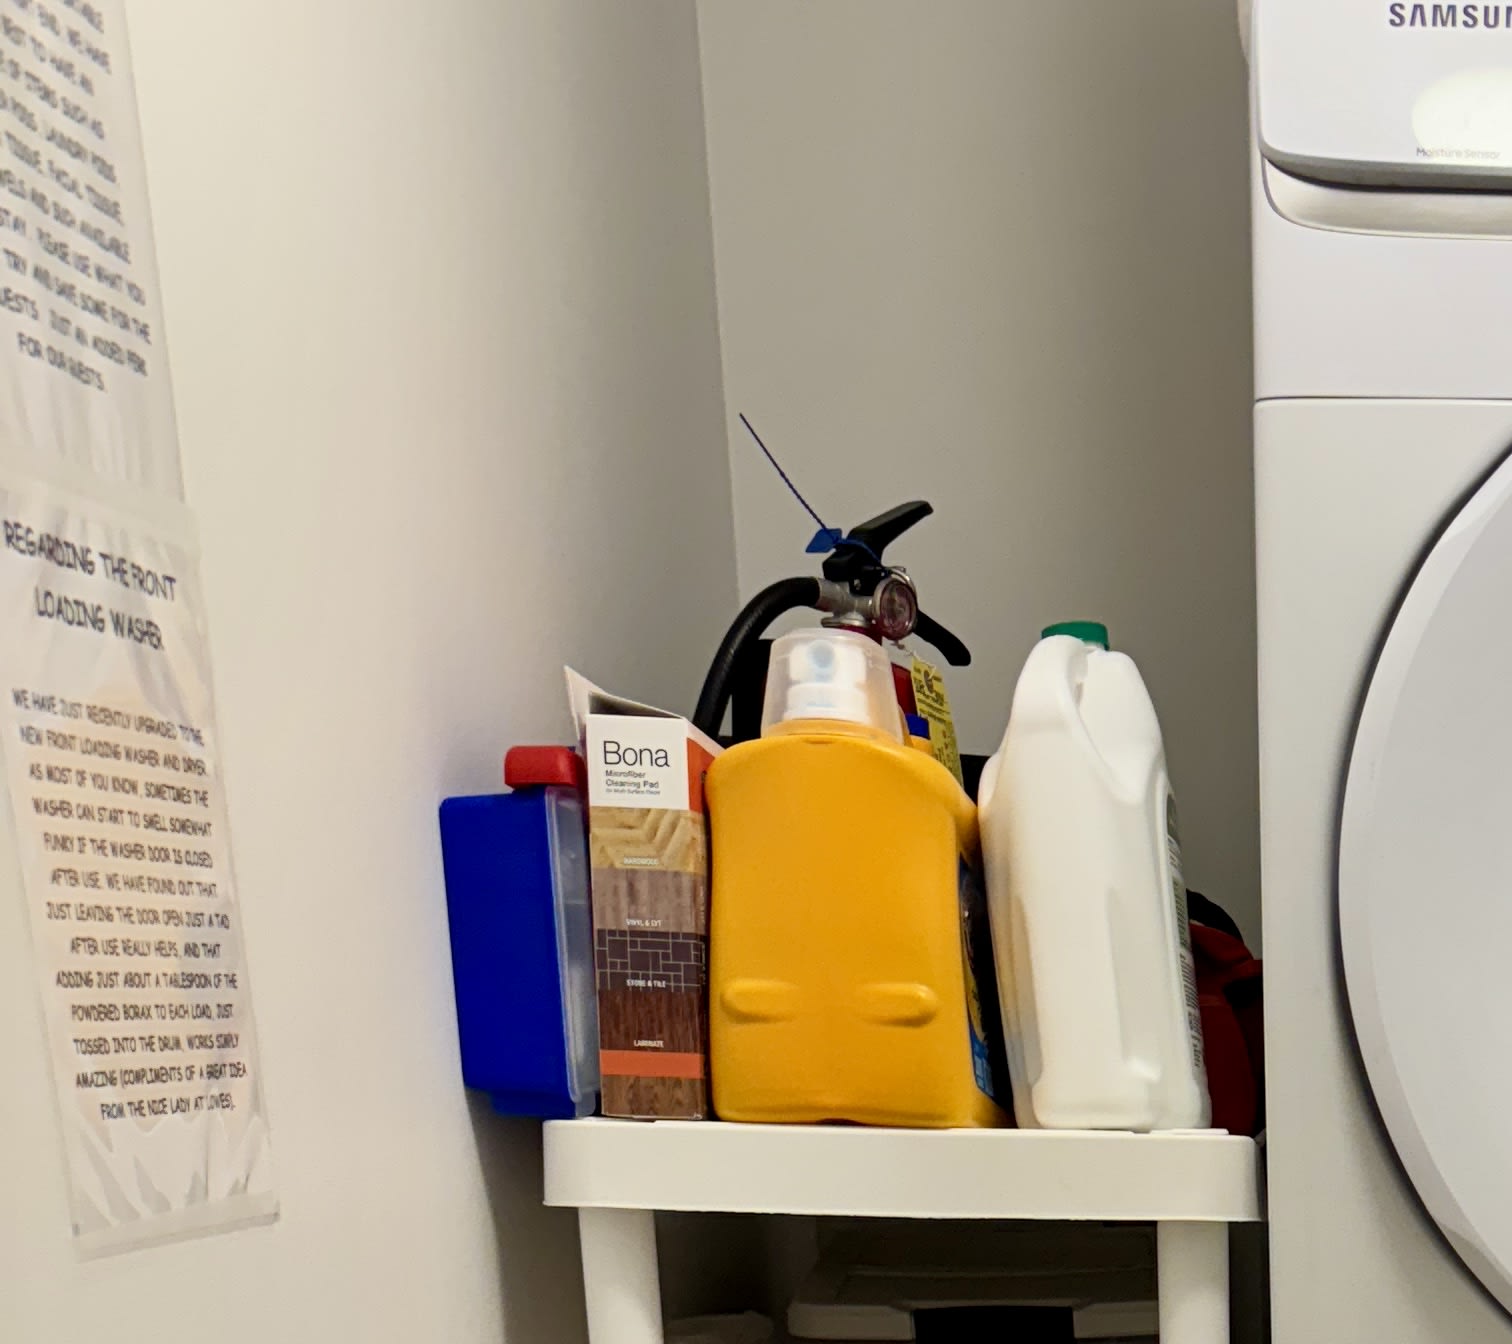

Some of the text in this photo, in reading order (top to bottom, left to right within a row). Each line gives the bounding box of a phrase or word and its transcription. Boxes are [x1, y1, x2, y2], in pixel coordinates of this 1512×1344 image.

[3, 518, 176, 602] REGARDING THE FRONT
[34, 585, 164, 651] LOADING WASHER
[604, 740, 670, 767] Bona
[96, 971, 120, 988] JUST
[124, 971, 152, 988] ABOUT
